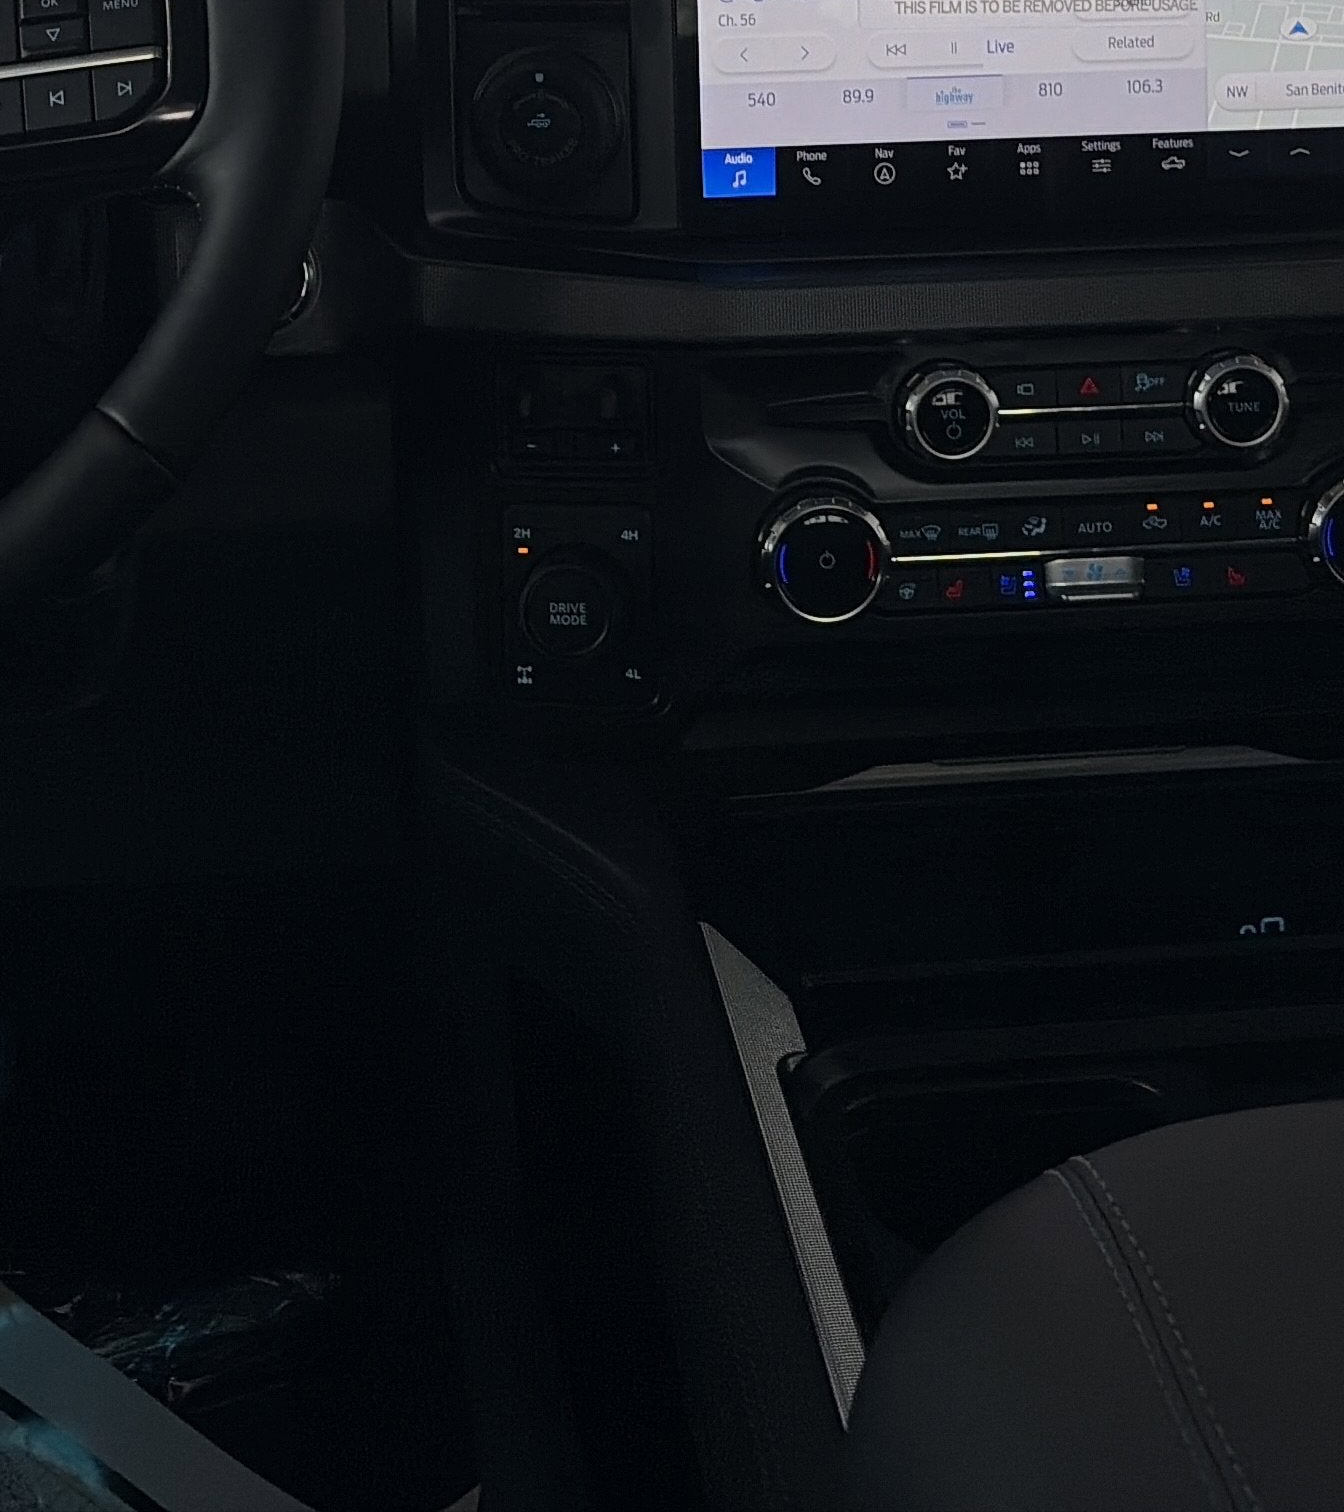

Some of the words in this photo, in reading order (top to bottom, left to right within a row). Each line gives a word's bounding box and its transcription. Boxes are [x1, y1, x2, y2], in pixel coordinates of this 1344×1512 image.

[895, 1, 926, 14] THIS
[929, 0, 962, 14] FILM
[965, 0, 978, 14] IS
[980, 0, 1000, 14] TO
[1003, 0, 1021, 13] BE
[1023, 0, 1091, 13] REMOVED
[1095, 0, 1151, 12] BEFORE
[718, 15, 736, 27] Ch.
[740, 14, 756, 26] 56
[1206, 11, 1220, 23] Rd
[987, 40, 1014, 55] Live
[1108, 36, 1155, 49] Related
[1038, 83, 1063, 97] 810
[1126, 79, 1163, 94] 106.3
[1227, 85, 1248, 99] NW
[1286, 84, 1307, 97] San
[748, 92, 776, 107] 540
[843, 89, 874, 104] 89.9
[935, 90, 974, 105] highway
[1017, 143, 1041, 156] Apps
[1081, 140, 1121, 153] Settings
[1152, 137, 1193, 150] Features
[796, 151, 827, 162] Phone
[875, 148, 894, 160] Nav
[948, 145, 966, 157] Fav
[724, 153, 753, 165] Audio
[1228, 401, 1260, 413] TUNE
[940, 409, 966, 420] VOL
[1200, 514, 1221, 527] A/C
[1256, 509, 1282, 520] MAX
[1078, 521, 1113, 533] AUTO
[1259, 519, 1281, 531] A/C
[512, 527, 531, 540] 2H
[620, 529, 640, 542] 4H
[549, 602, 587, 615] DRIVE
[549, 614, 587, 626] MODE
[625, 668, 642, 680] 4L
